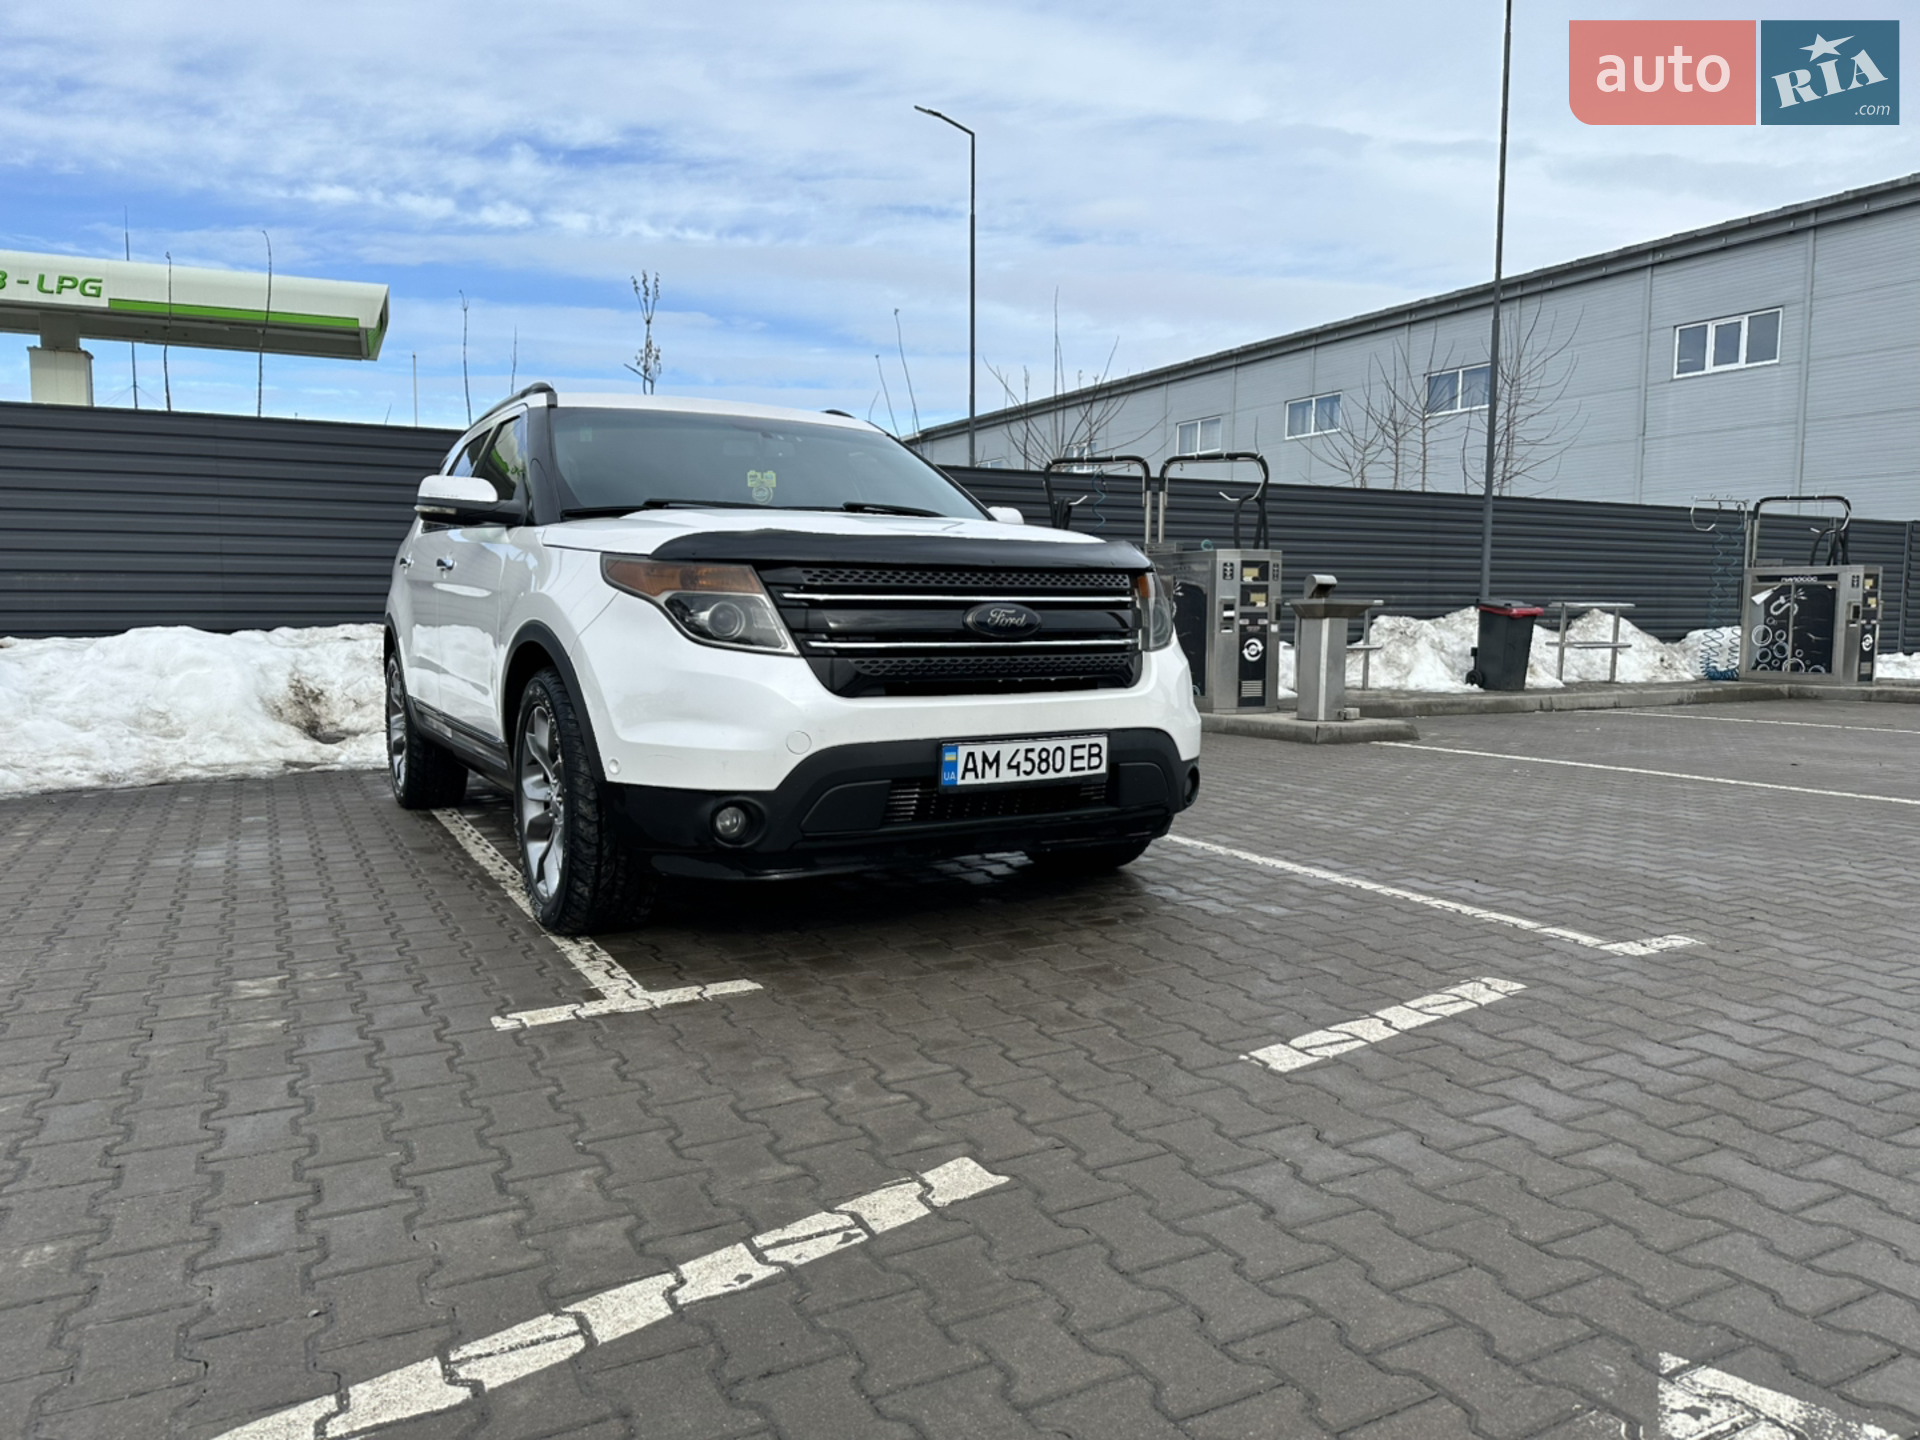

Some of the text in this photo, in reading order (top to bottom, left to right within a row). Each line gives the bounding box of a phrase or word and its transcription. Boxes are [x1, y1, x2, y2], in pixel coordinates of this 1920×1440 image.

[36, 273, 103, 298] LPG
[987, 607, 1027, 628] Ford
[960, 742, 1103, 780] AM 4580 EB
[943, 771, 957, 781] UA
